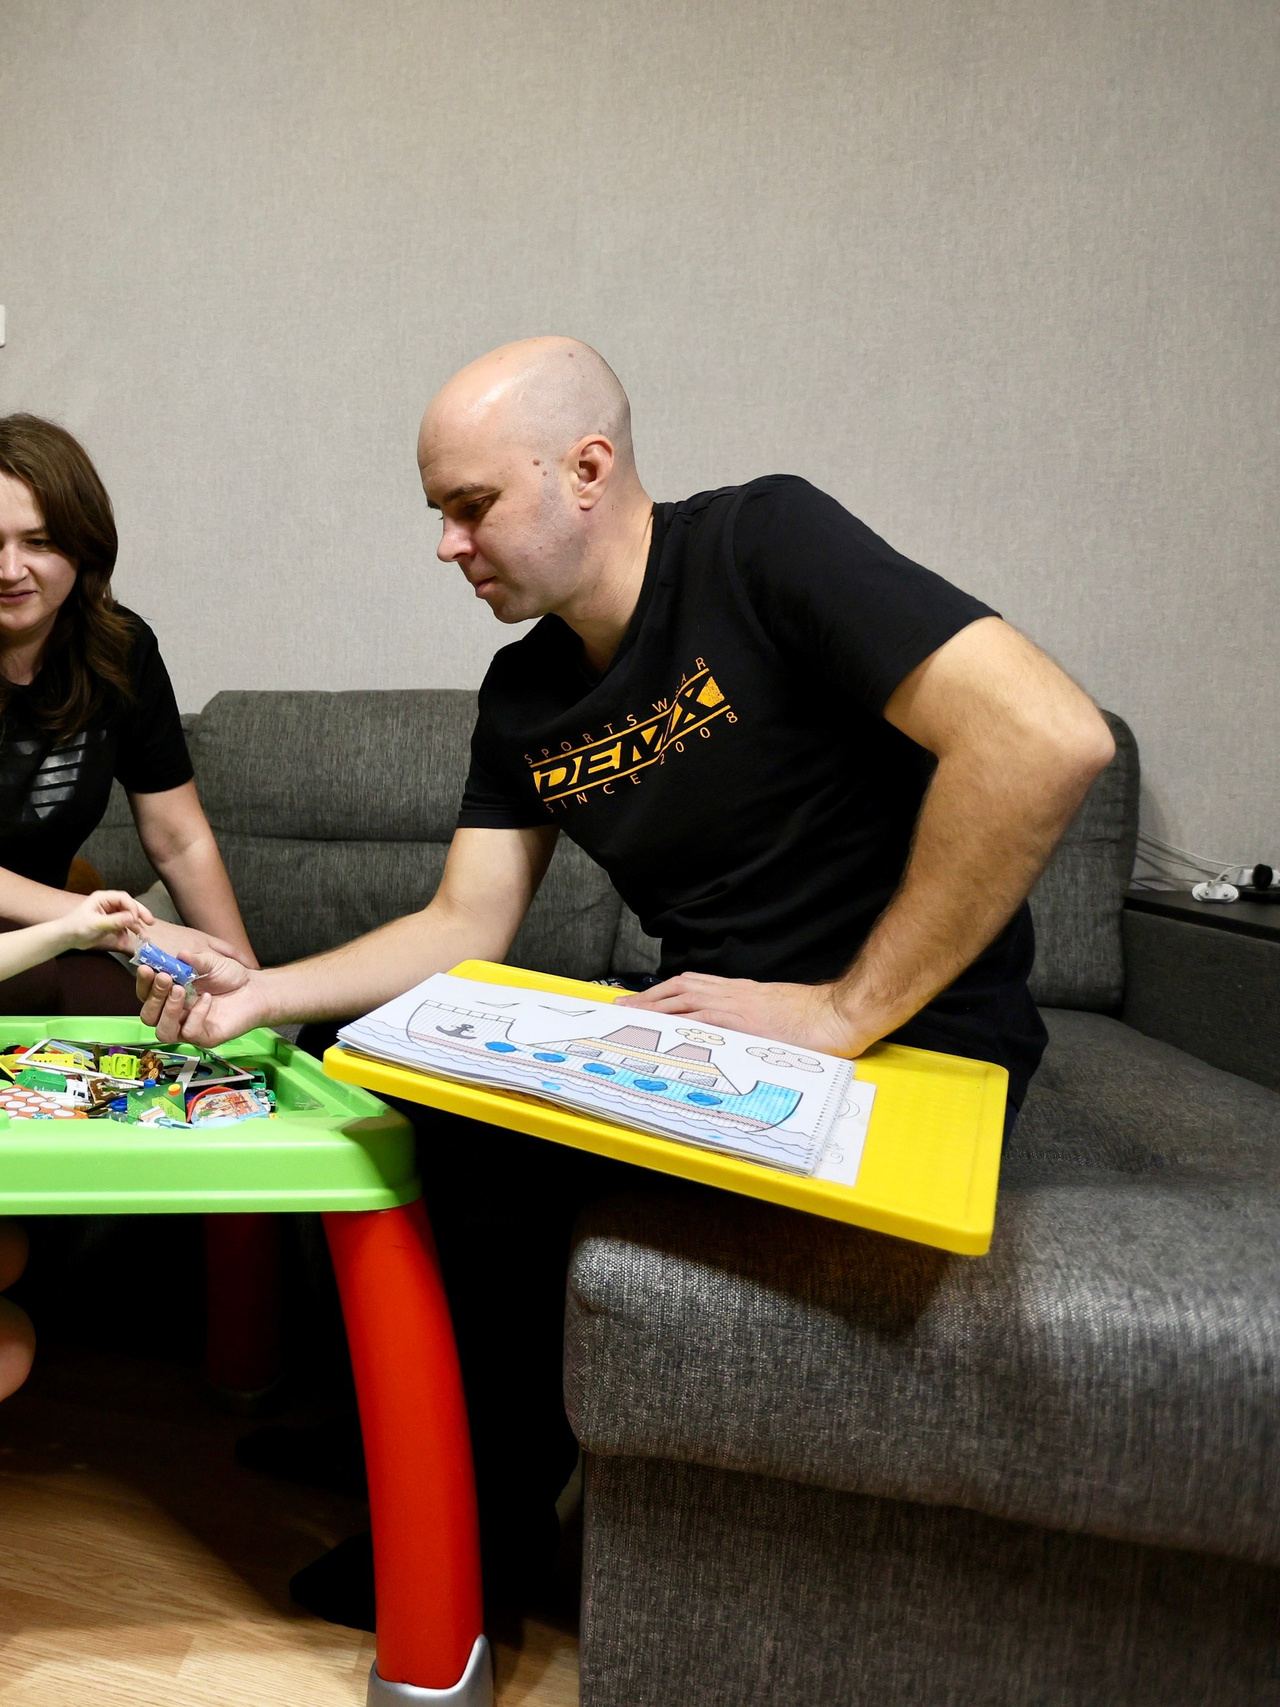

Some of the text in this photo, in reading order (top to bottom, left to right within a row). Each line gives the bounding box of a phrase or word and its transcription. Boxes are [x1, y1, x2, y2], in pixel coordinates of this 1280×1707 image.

[524, 657, 706, 764] SPORTSWAR
[546, 711, 738, 813] SINCE 2008
